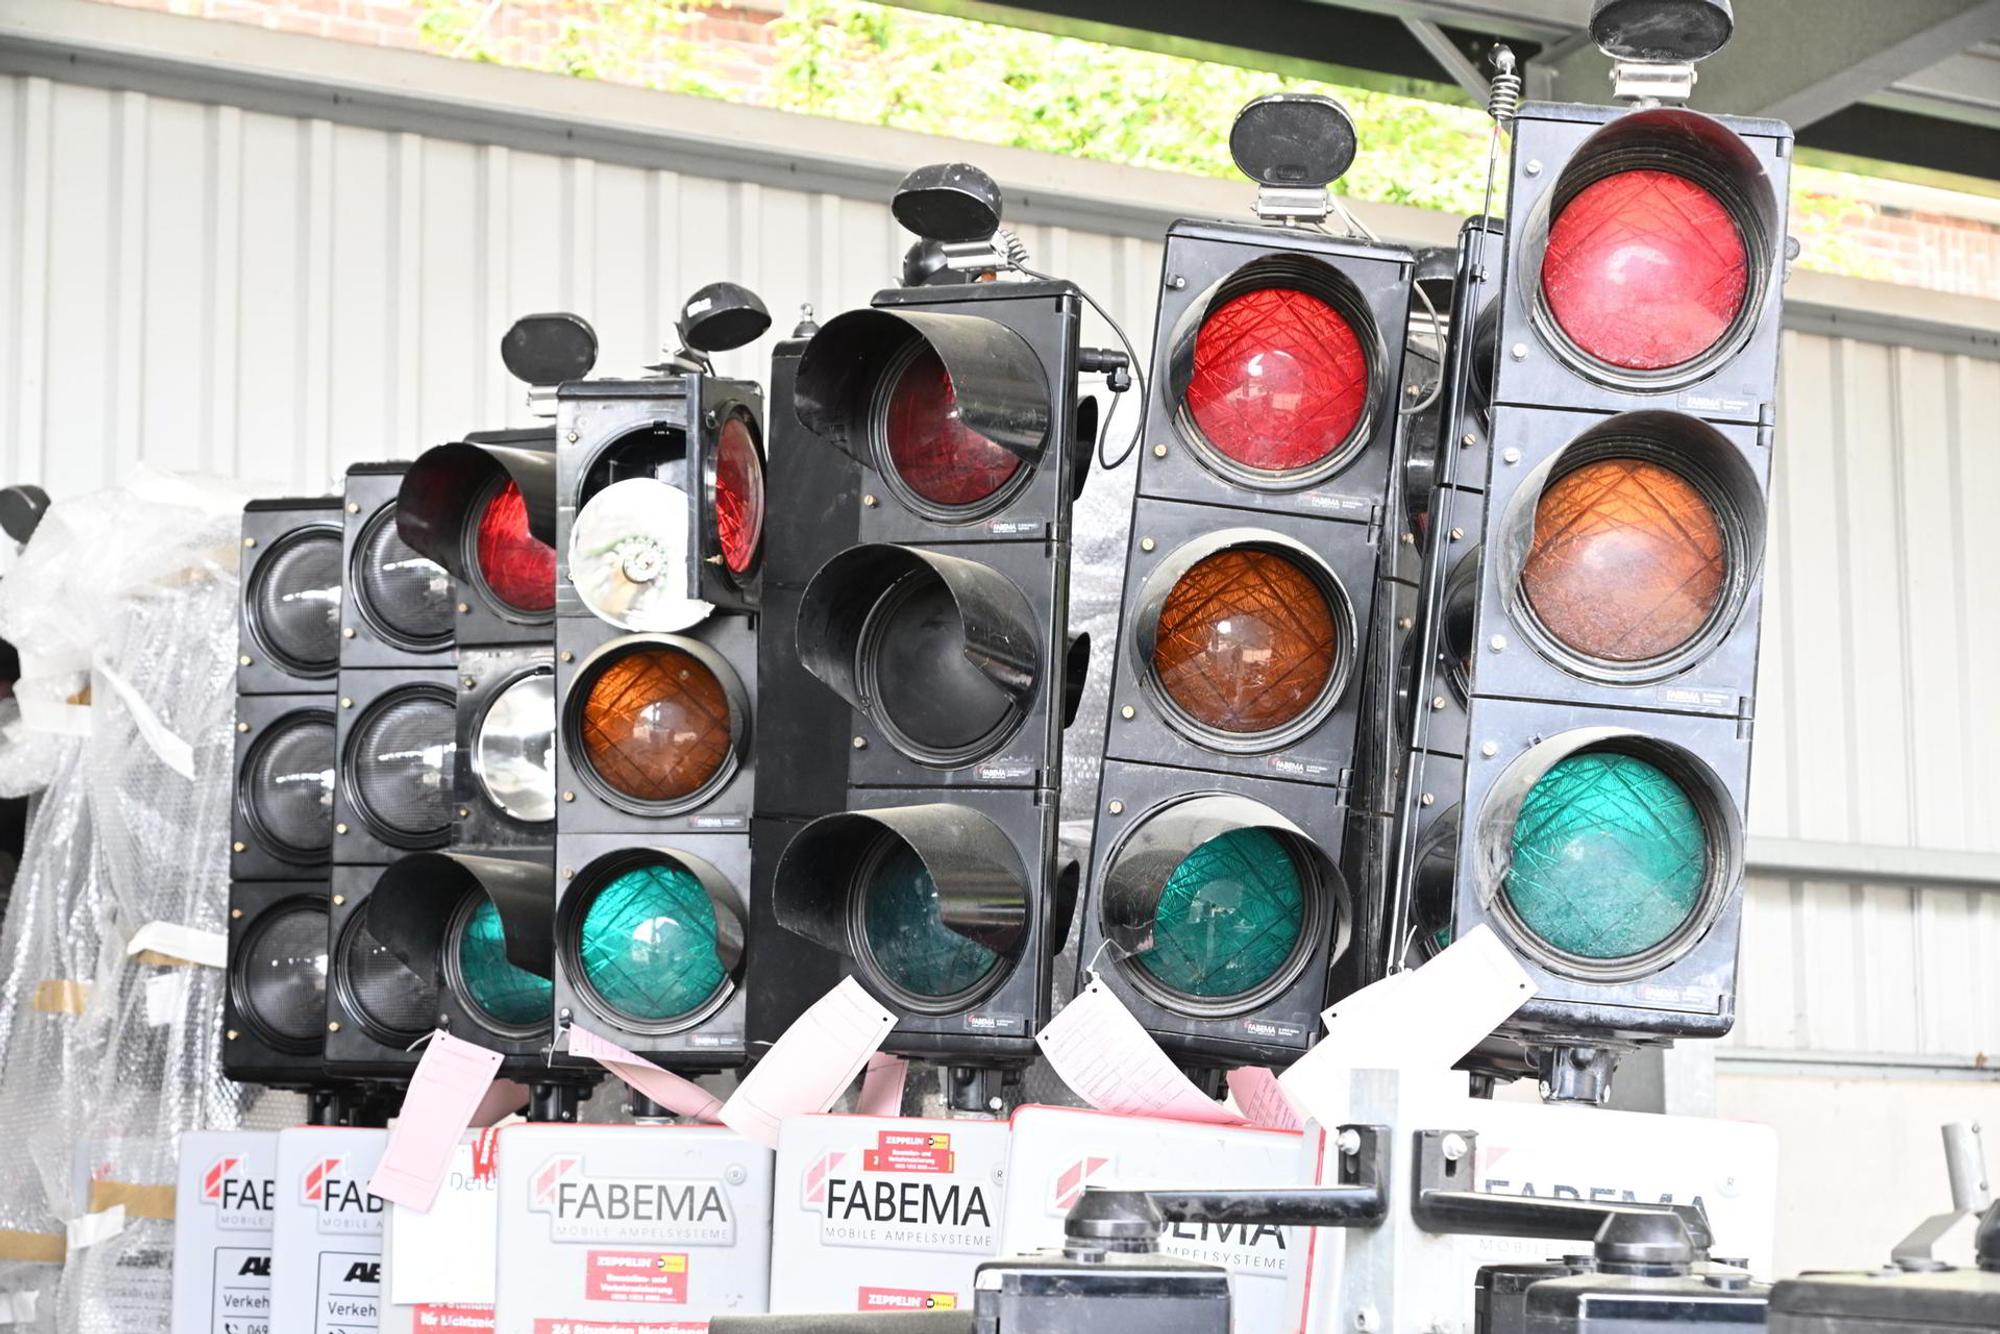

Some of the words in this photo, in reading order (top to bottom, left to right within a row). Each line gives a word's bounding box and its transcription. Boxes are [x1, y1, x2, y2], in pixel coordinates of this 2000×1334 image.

[558, 1183, 728, 1223] FABEMA
[827, 1178, 991, 1228] FABEMA
[221, 1215, 268, 1227] MOBILE
[322, 1217, 367, 1229] MOBILE
[556, 1225, 610, 1238] MOBILE
[620, 1226, 729, 1240] AMPELSYSTEME
[825, 1227, 877, 1241] MOBILE
[885, 1230, 993, 1247] AMPELSYSTEME
[868, 1293, 922, 1307] ZEPPELIN
[328, 1300, 378, 1318] Verkeh
